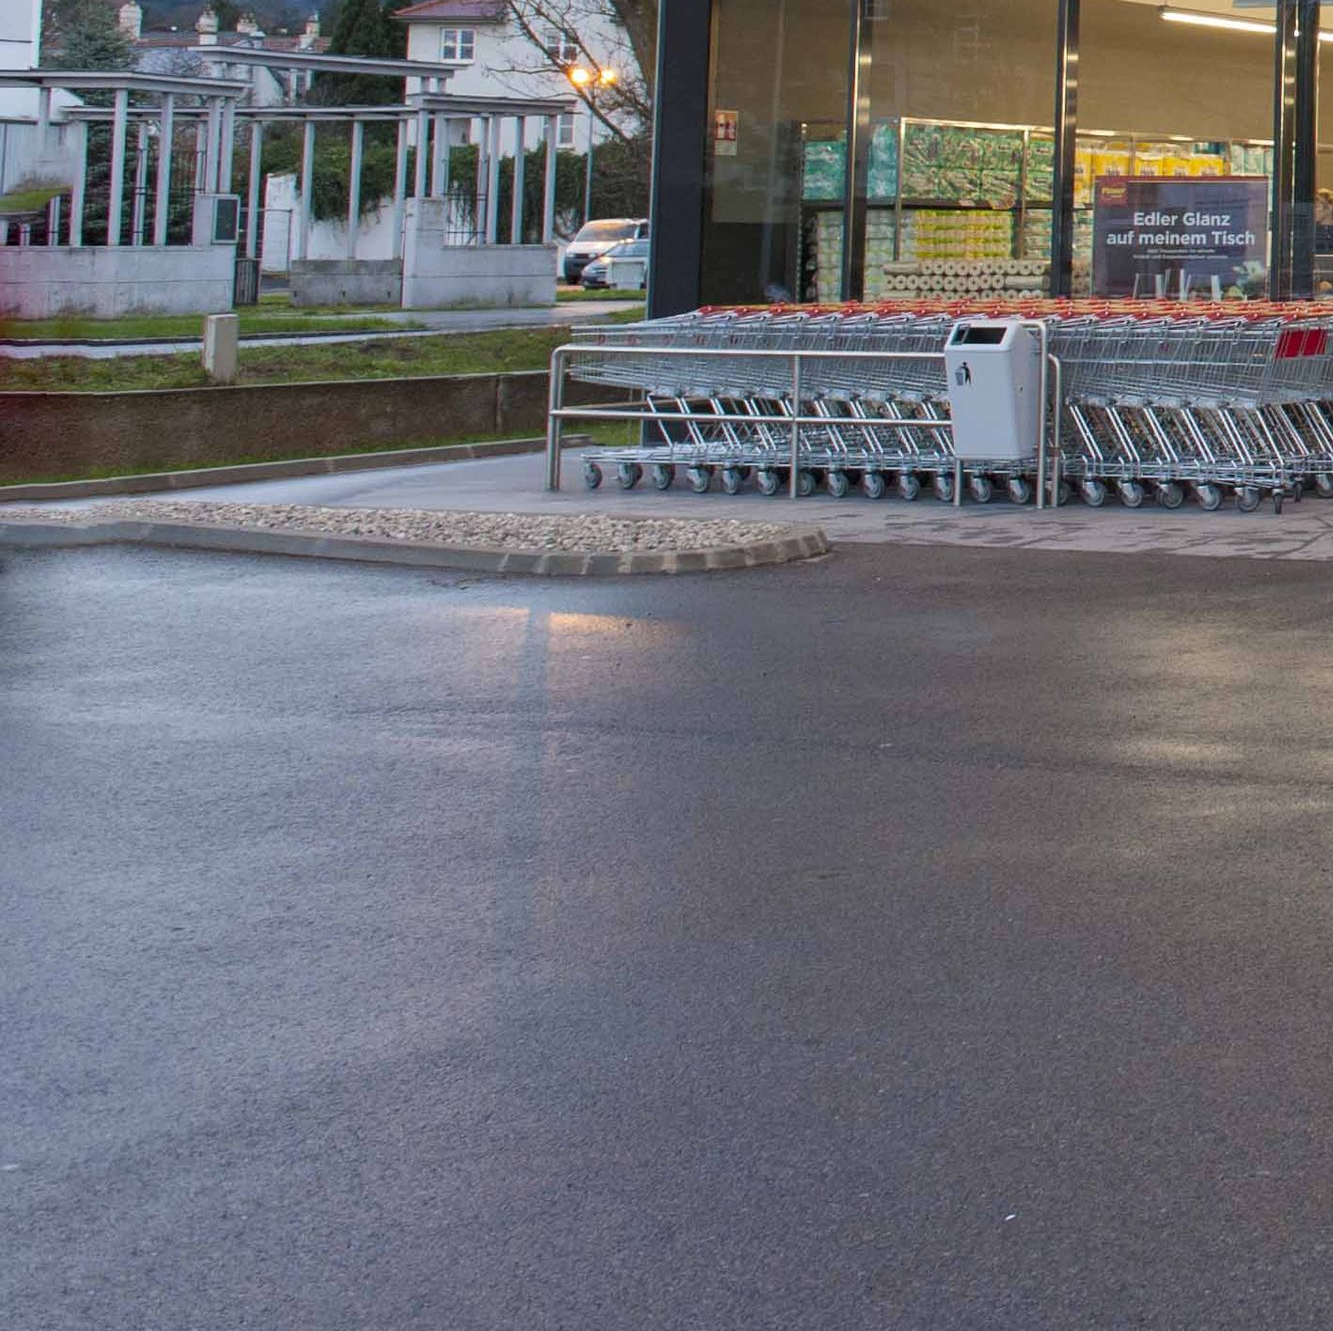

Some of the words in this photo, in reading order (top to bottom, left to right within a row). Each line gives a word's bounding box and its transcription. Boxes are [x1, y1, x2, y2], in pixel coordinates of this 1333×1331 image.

[1133, 212, 1178, 226] Edler
[1183, 212, 1231, 226] Glanz
[1106, 230, 1134, 245] auf
[1138, 231, 1207, 245] meinem
[1211, 230, 1255, 245] Tisch
